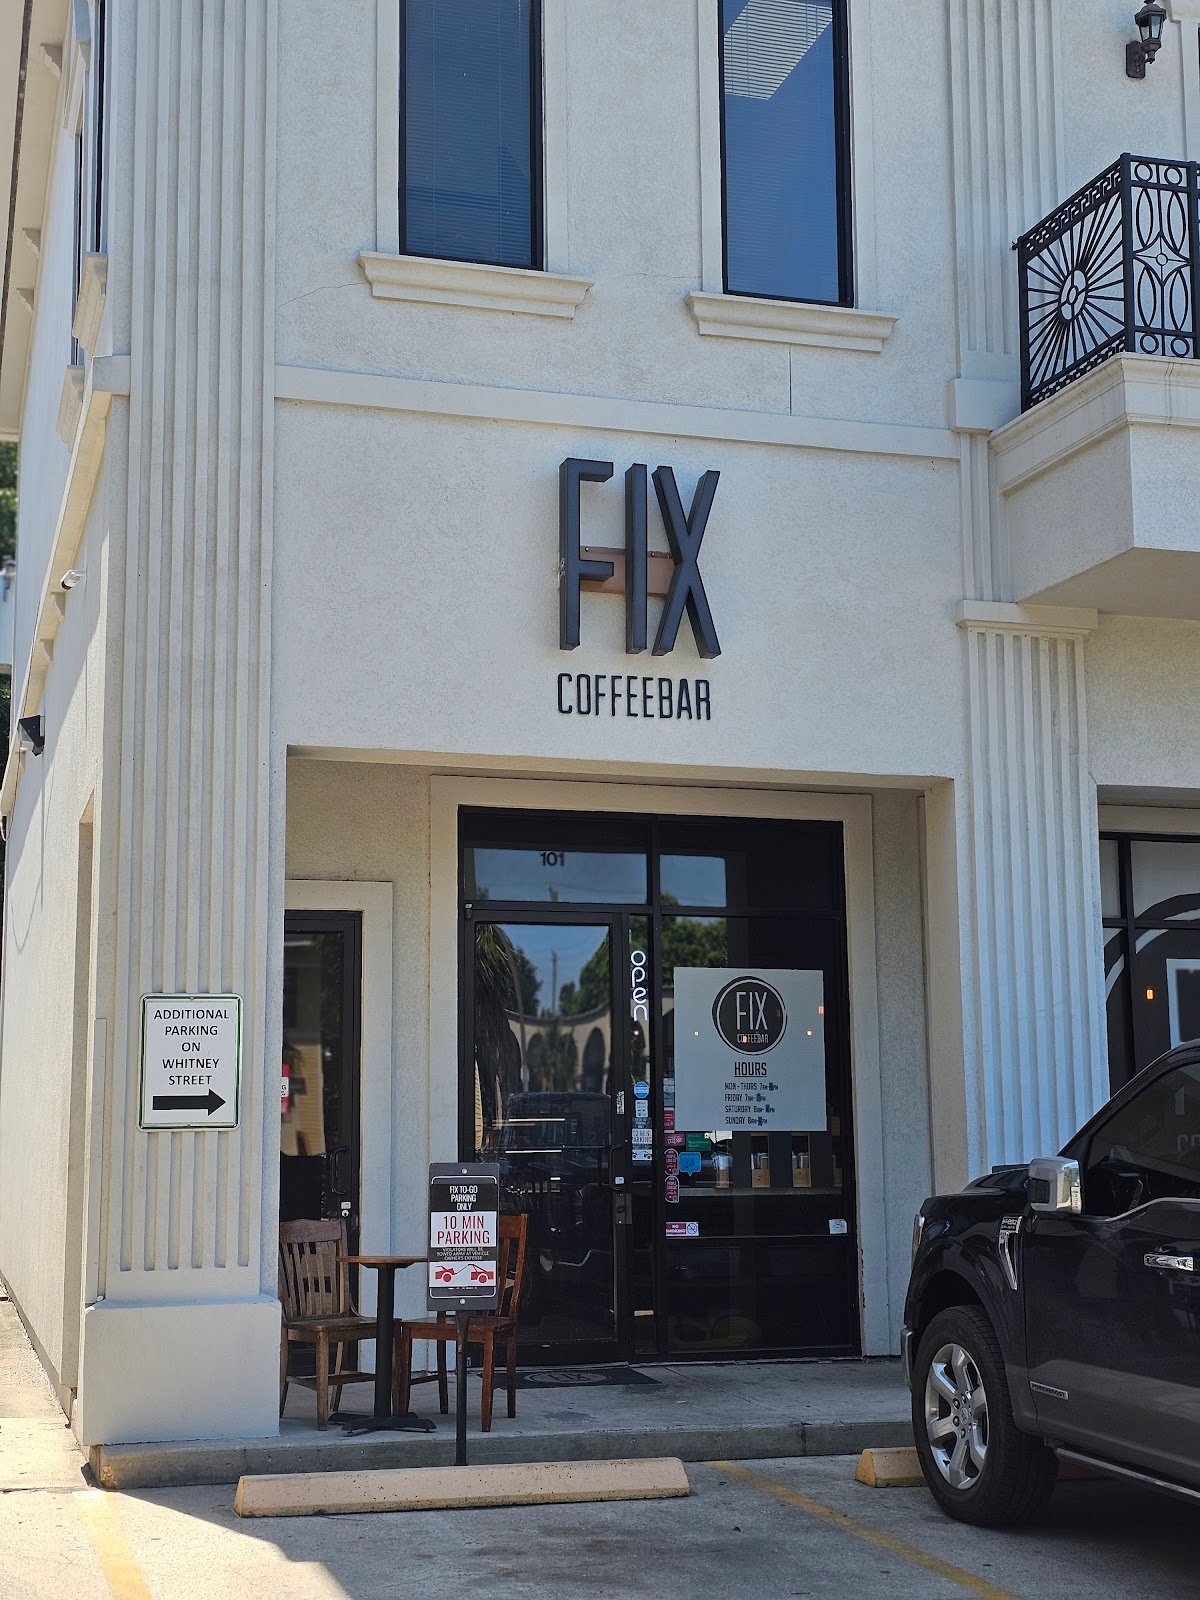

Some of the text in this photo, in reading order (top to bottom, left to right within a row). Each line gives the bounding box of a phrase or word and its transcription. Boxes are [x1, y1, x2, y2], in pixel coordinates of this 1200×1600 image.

[559, 457, 722, 659] FIX
[557, 672, 711, 721] COFFEEBAR
[540, 851, 565, 867] 101
[630, 950, 648, 1022] open
[153, 1009, 230, 1020] ADDITIONAL
[736, 991, 768, 1031] FIX
[164, 1025, 218, 1036] PARKING
[181, 1041, 201, 1052] ON
[162, 1058, 220, 1069] WHITNEY
[734, 1062, 767, 1076] HOURS
[168, 1075, 213, 1086] STREET
[724, 1093, 743, 1102] FRIDAY
[724, 1105, 751, 1113] SATURDAY
[725, 1116, 746, 1125] SUNDAY
[449, 1185, 478, 1194] FIX TO-GO
[450, 1194, 477, 1203] PARKING
[456, 1202, 473, 1211] ONLY
[443, 1215, 484, 1230] 10 MIN
[437, 1230, 490, 1245] PARKING
